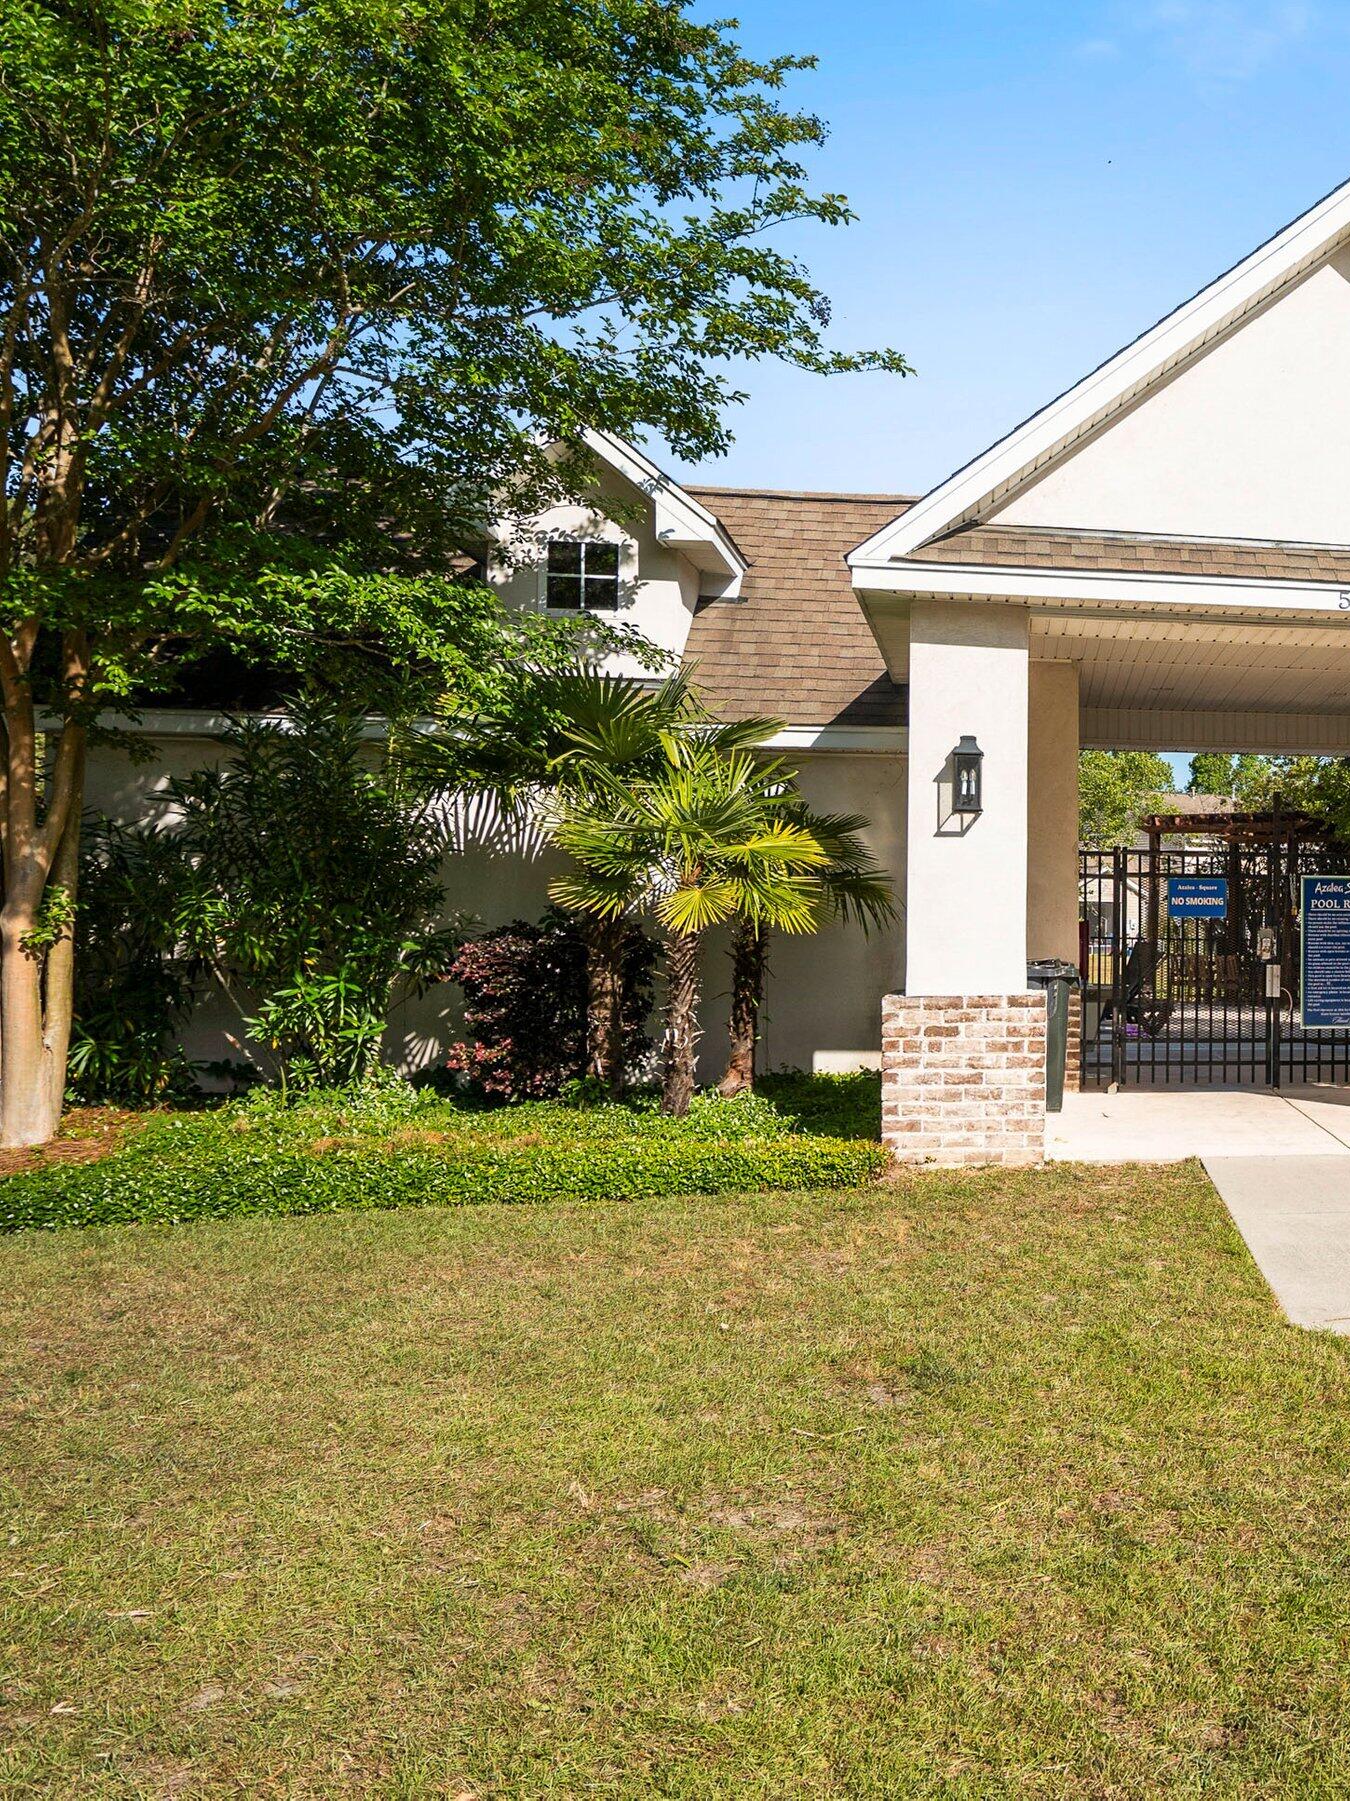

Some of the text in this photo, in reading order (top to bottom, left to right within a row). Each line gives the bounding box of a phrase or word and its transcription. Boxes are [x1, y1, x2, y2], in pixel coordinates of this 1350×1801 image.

[1314, 882, 1344, 895] Azalea
[1171, 897, 1224, 906] NO SMOKING
[1311, 899, 1340, 909] POOL
